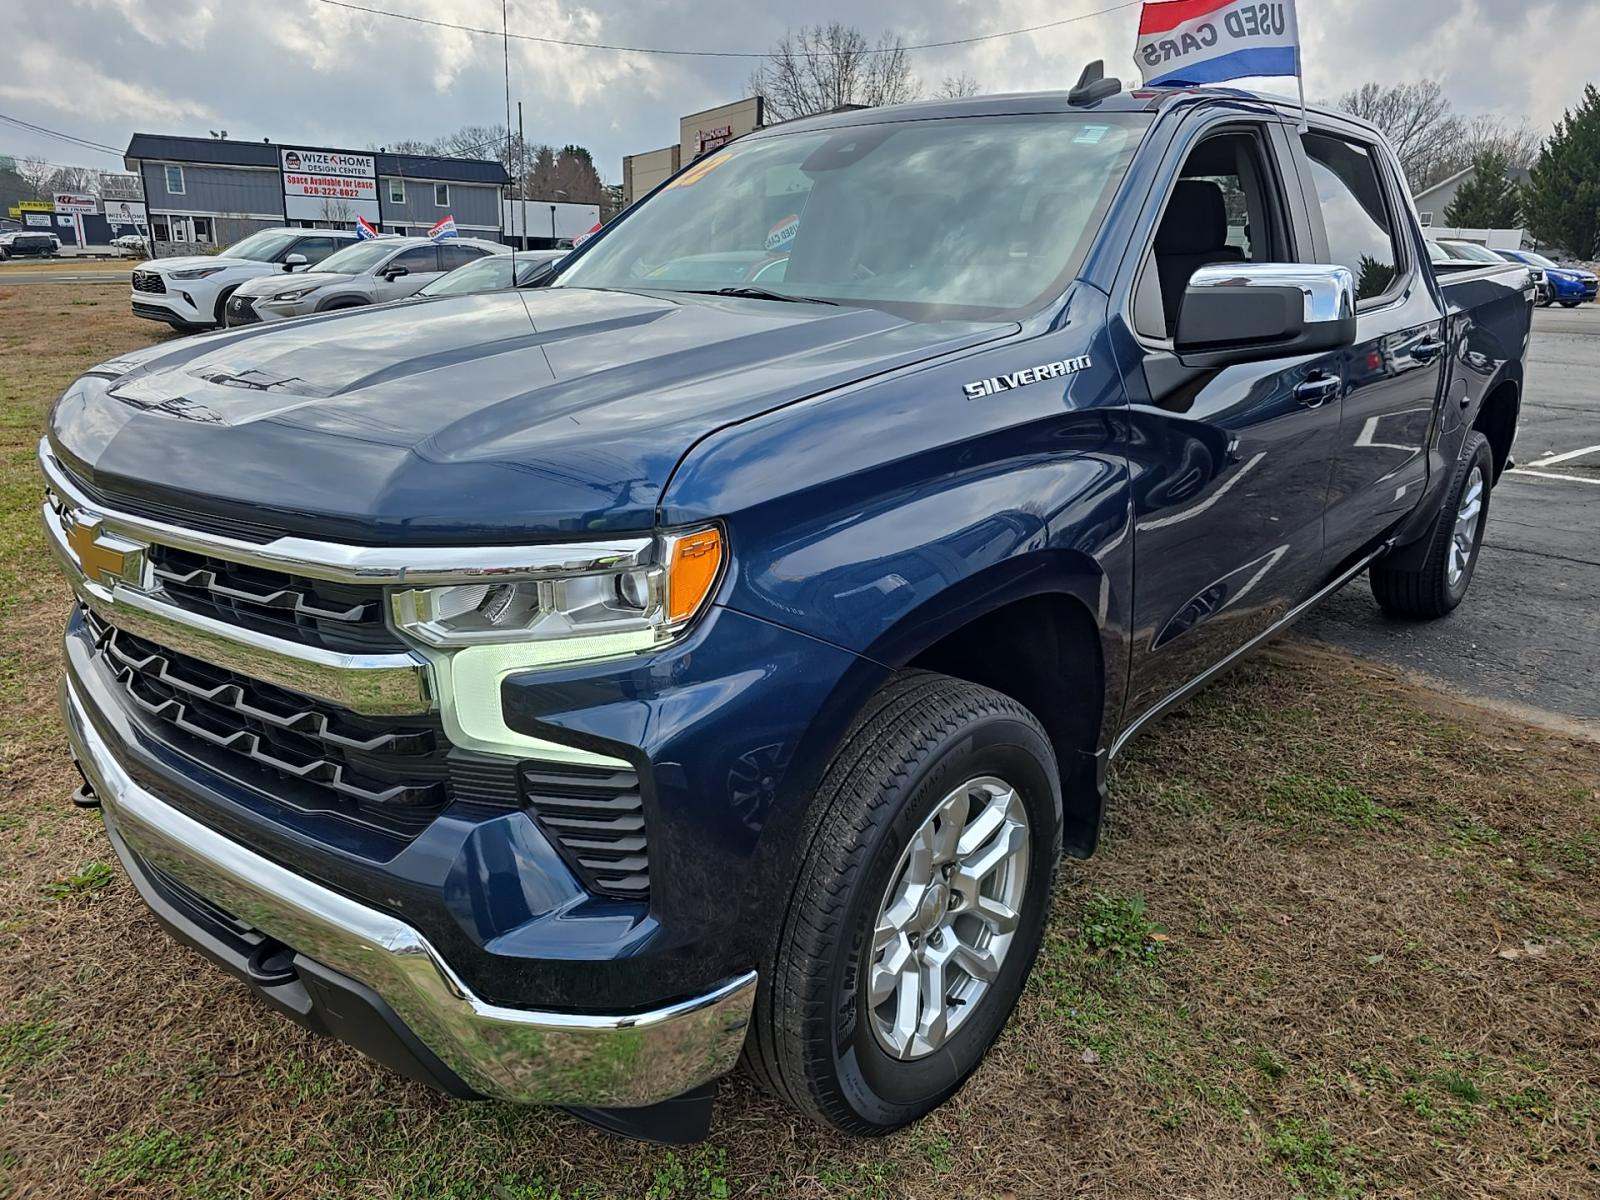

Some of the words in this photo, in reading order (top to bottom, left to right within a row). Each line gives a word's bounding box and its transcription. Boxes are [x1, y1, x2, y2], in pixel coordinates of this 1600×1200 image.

[301, 153, 329, 164] WIZE
[340, 157, 371, 168] HOME
[308, 164, 337, 173] DESIGN
[338, 166, 367, 175] CENTER
[287, 175, 308, 184] Space
[310, 176, 341, 187] Available
[343, 179, 352, 188] for
[354, 180, 373, 189] Lease
[963, 354, 1092, 401] SILVERADO
